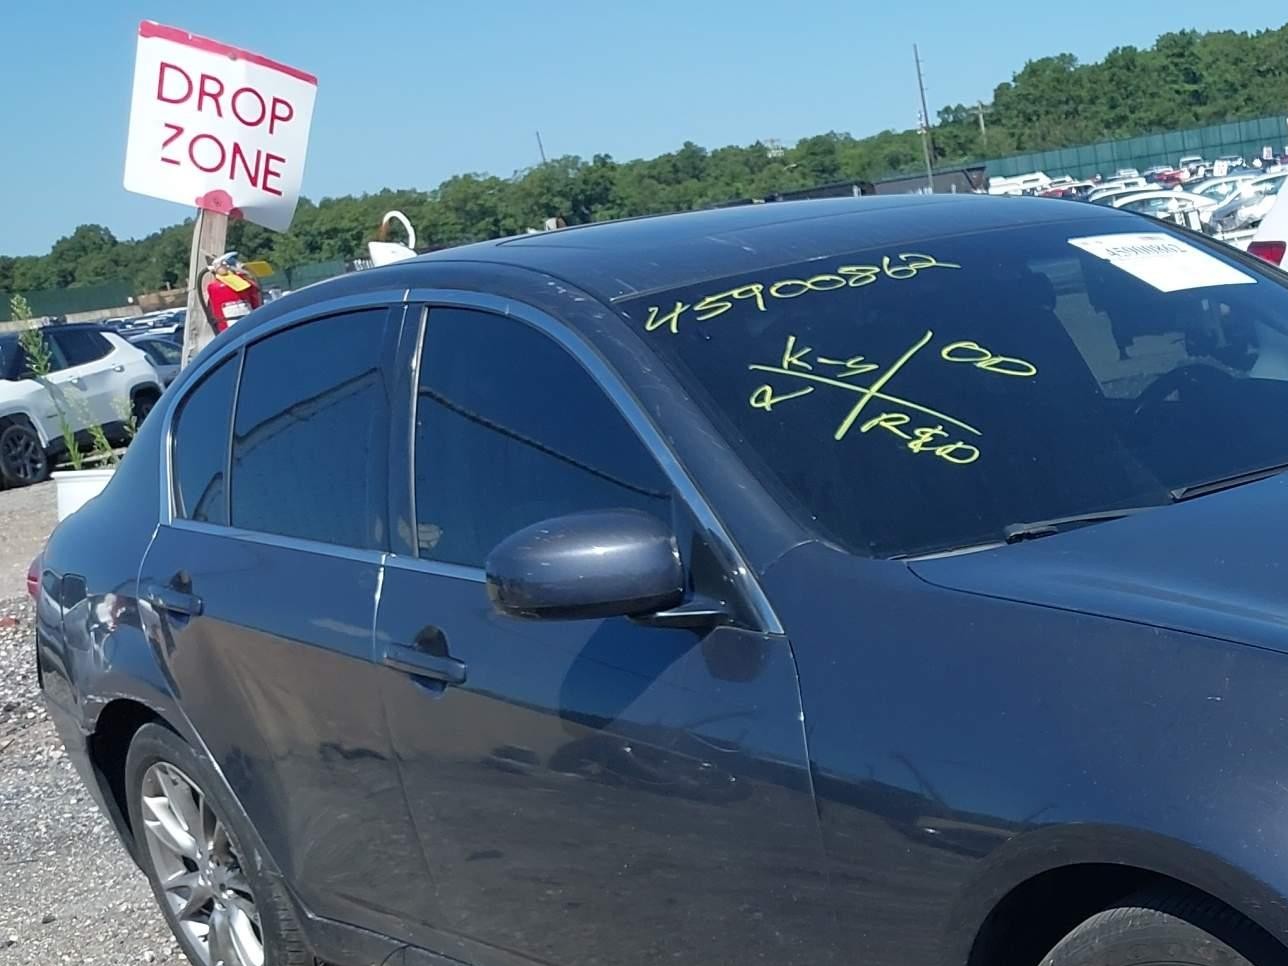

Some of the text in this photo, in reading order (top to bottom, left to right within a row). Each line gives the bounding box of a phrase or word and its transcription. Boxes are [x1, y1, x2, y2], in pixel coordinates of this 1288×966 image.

[157, 61, 294, 135] DROP
[160, 122, 286, 196] ZONE
[644, 253, 962, 334] 45900862
